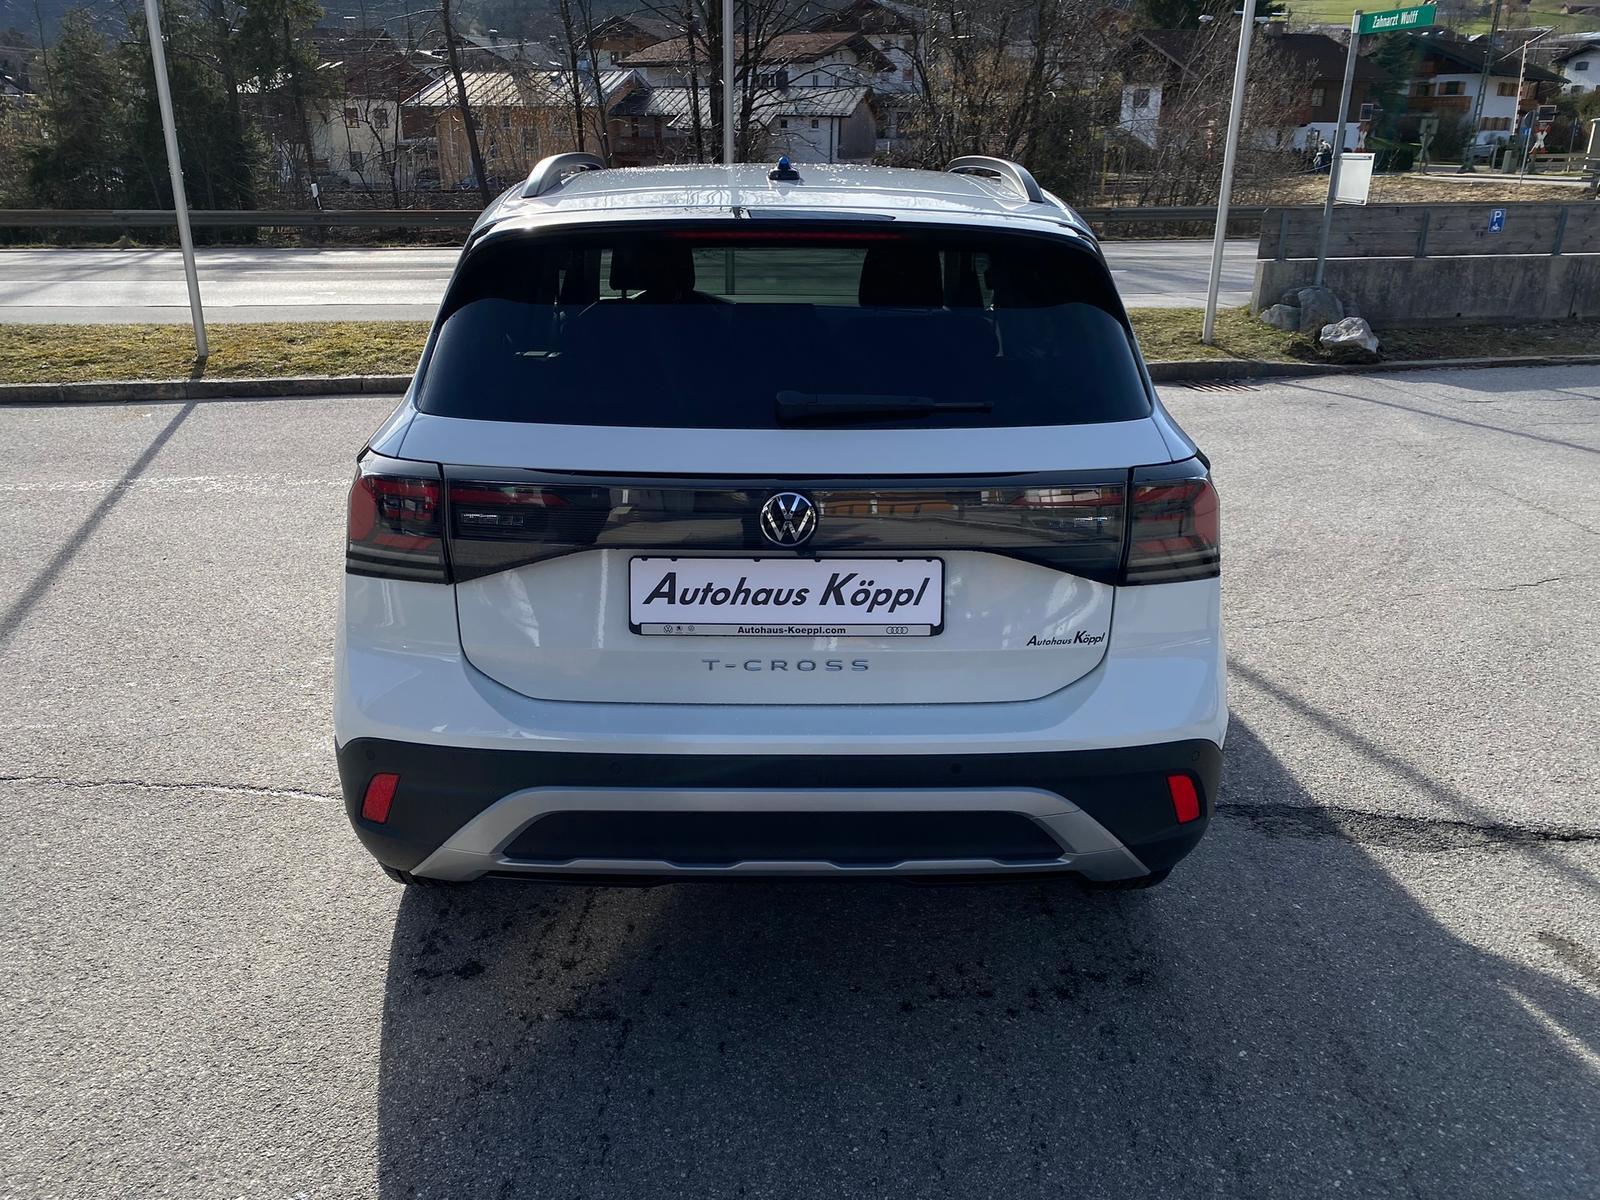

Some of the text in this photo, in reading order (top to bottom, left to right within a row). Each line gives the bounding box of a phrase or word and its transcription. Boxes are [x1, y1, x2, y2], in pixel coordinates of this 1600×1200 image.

[1372, 14, 1399, 28] Zahnarzt
[1494, 210, 1502, 222] P
[642, 571, 931, 613] Autohaus Köppl
[737, 626, 846, 635] Autohaus-Koeppl.com
[1026, 630, 1106, 646] Autohaus Köppl
[701, 659, 870, 672] T-CROSS
